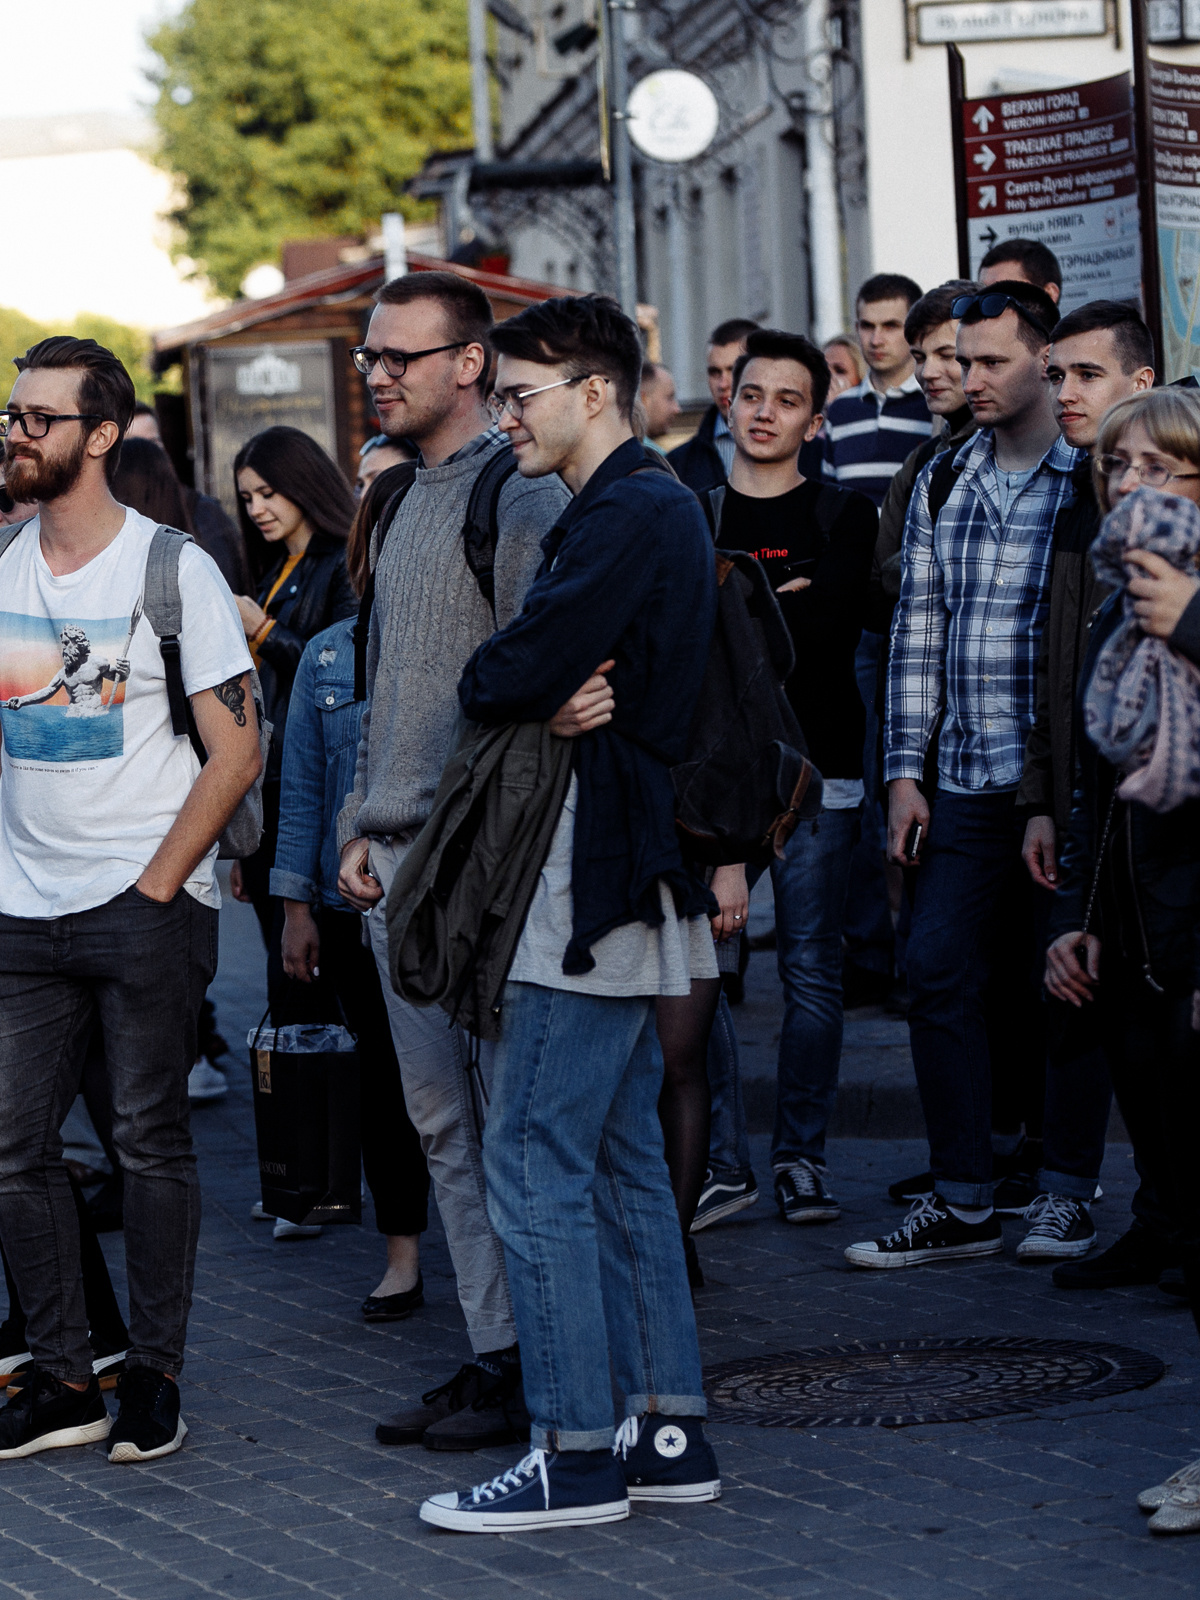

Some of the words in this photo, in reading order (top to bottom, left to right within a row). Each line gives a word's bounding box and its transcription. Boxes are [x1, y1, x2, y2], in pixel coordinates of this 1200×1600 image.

[1001, 97, 1045, 117] ВЕРХНІ
[1046, 91, 1080, 110] ГОРАД
[1047, 213, 1085, 229] НЯМІГА
[760, 548, 788, 559] Time
[259, 1161, 287, 1176] ASCONI
